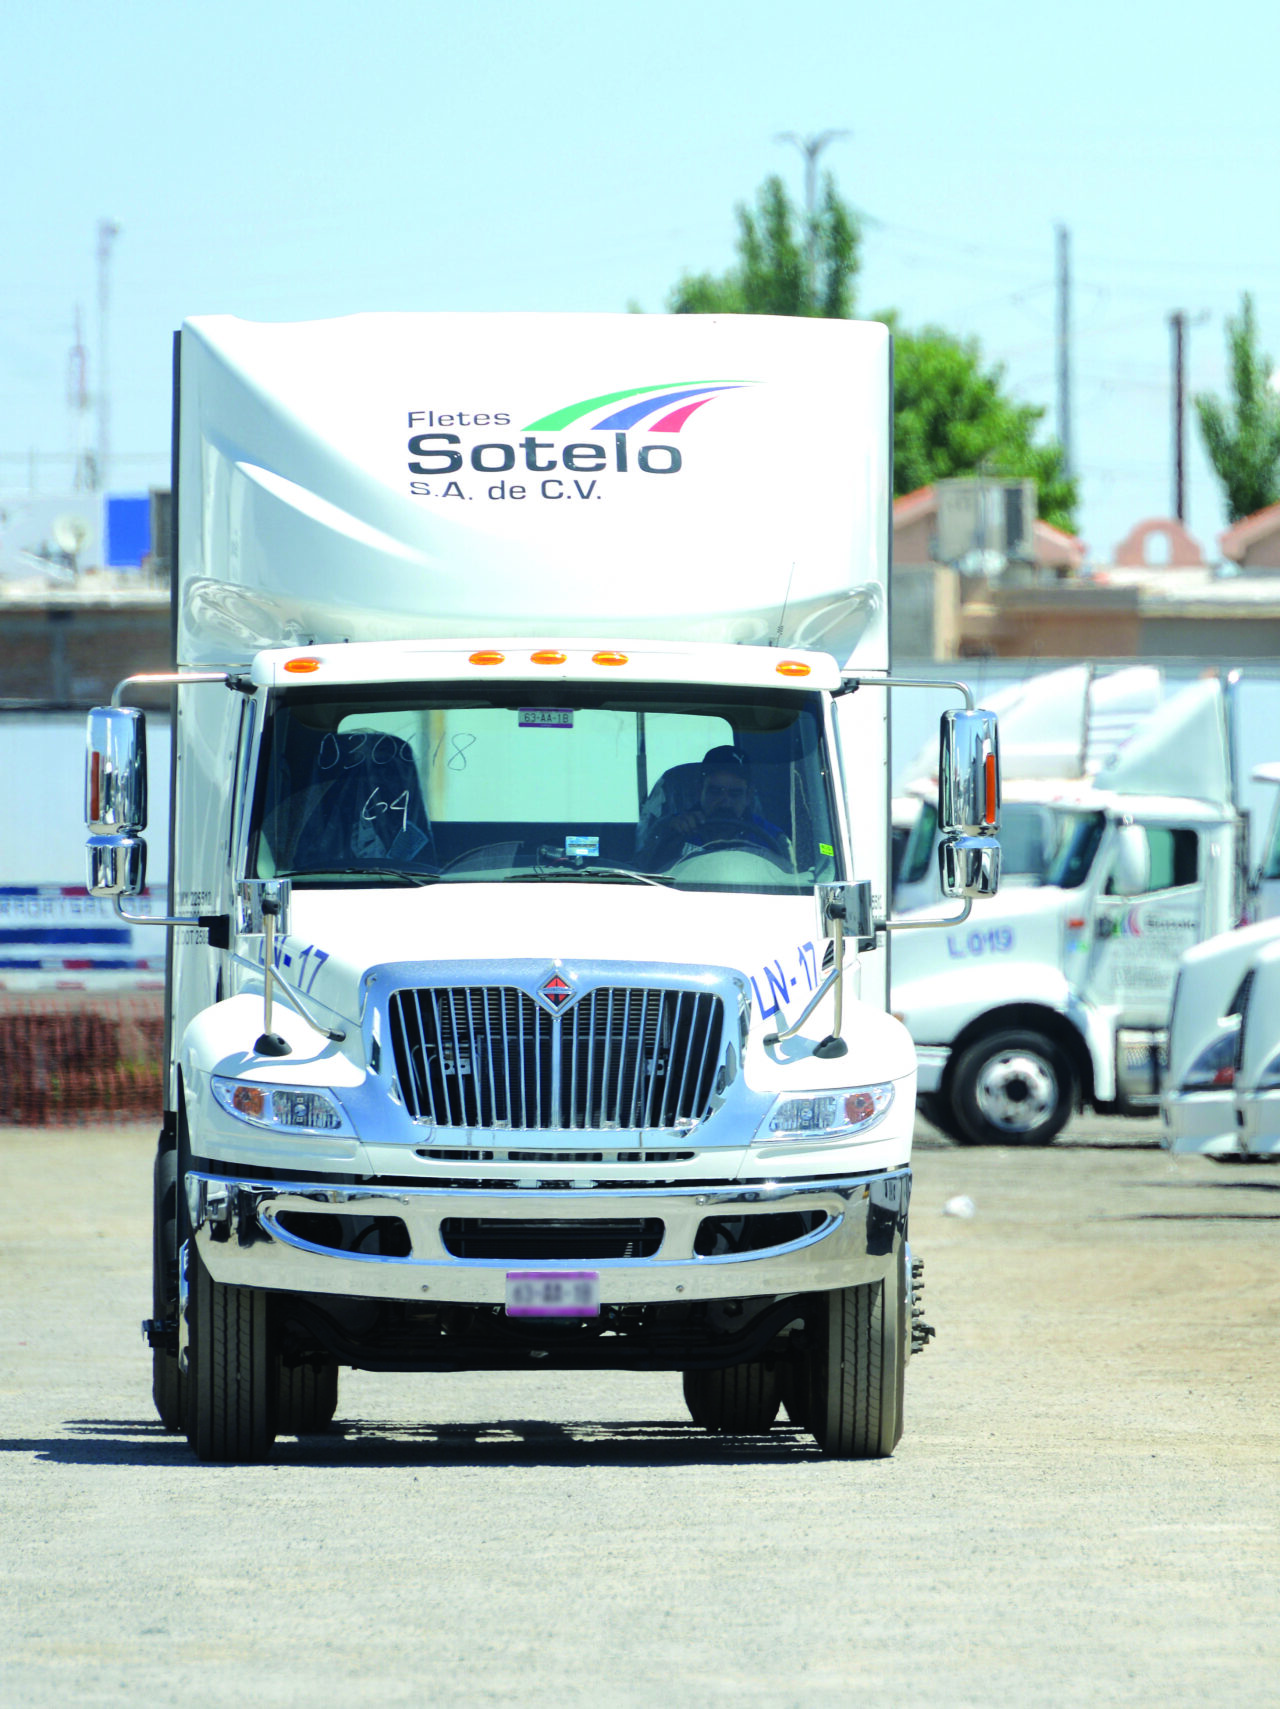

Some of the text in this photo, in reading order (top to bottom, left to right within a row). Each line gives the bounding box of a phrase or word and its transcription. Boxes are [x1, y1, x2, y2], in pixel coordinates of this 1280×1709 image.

[407, 410, 511, 428] Fletes
[407, 432, 683, 475] Sotelo
[409, 479, 602, 500] S.A. de C.V.
[750, 941, 818, 1020] LN-17
